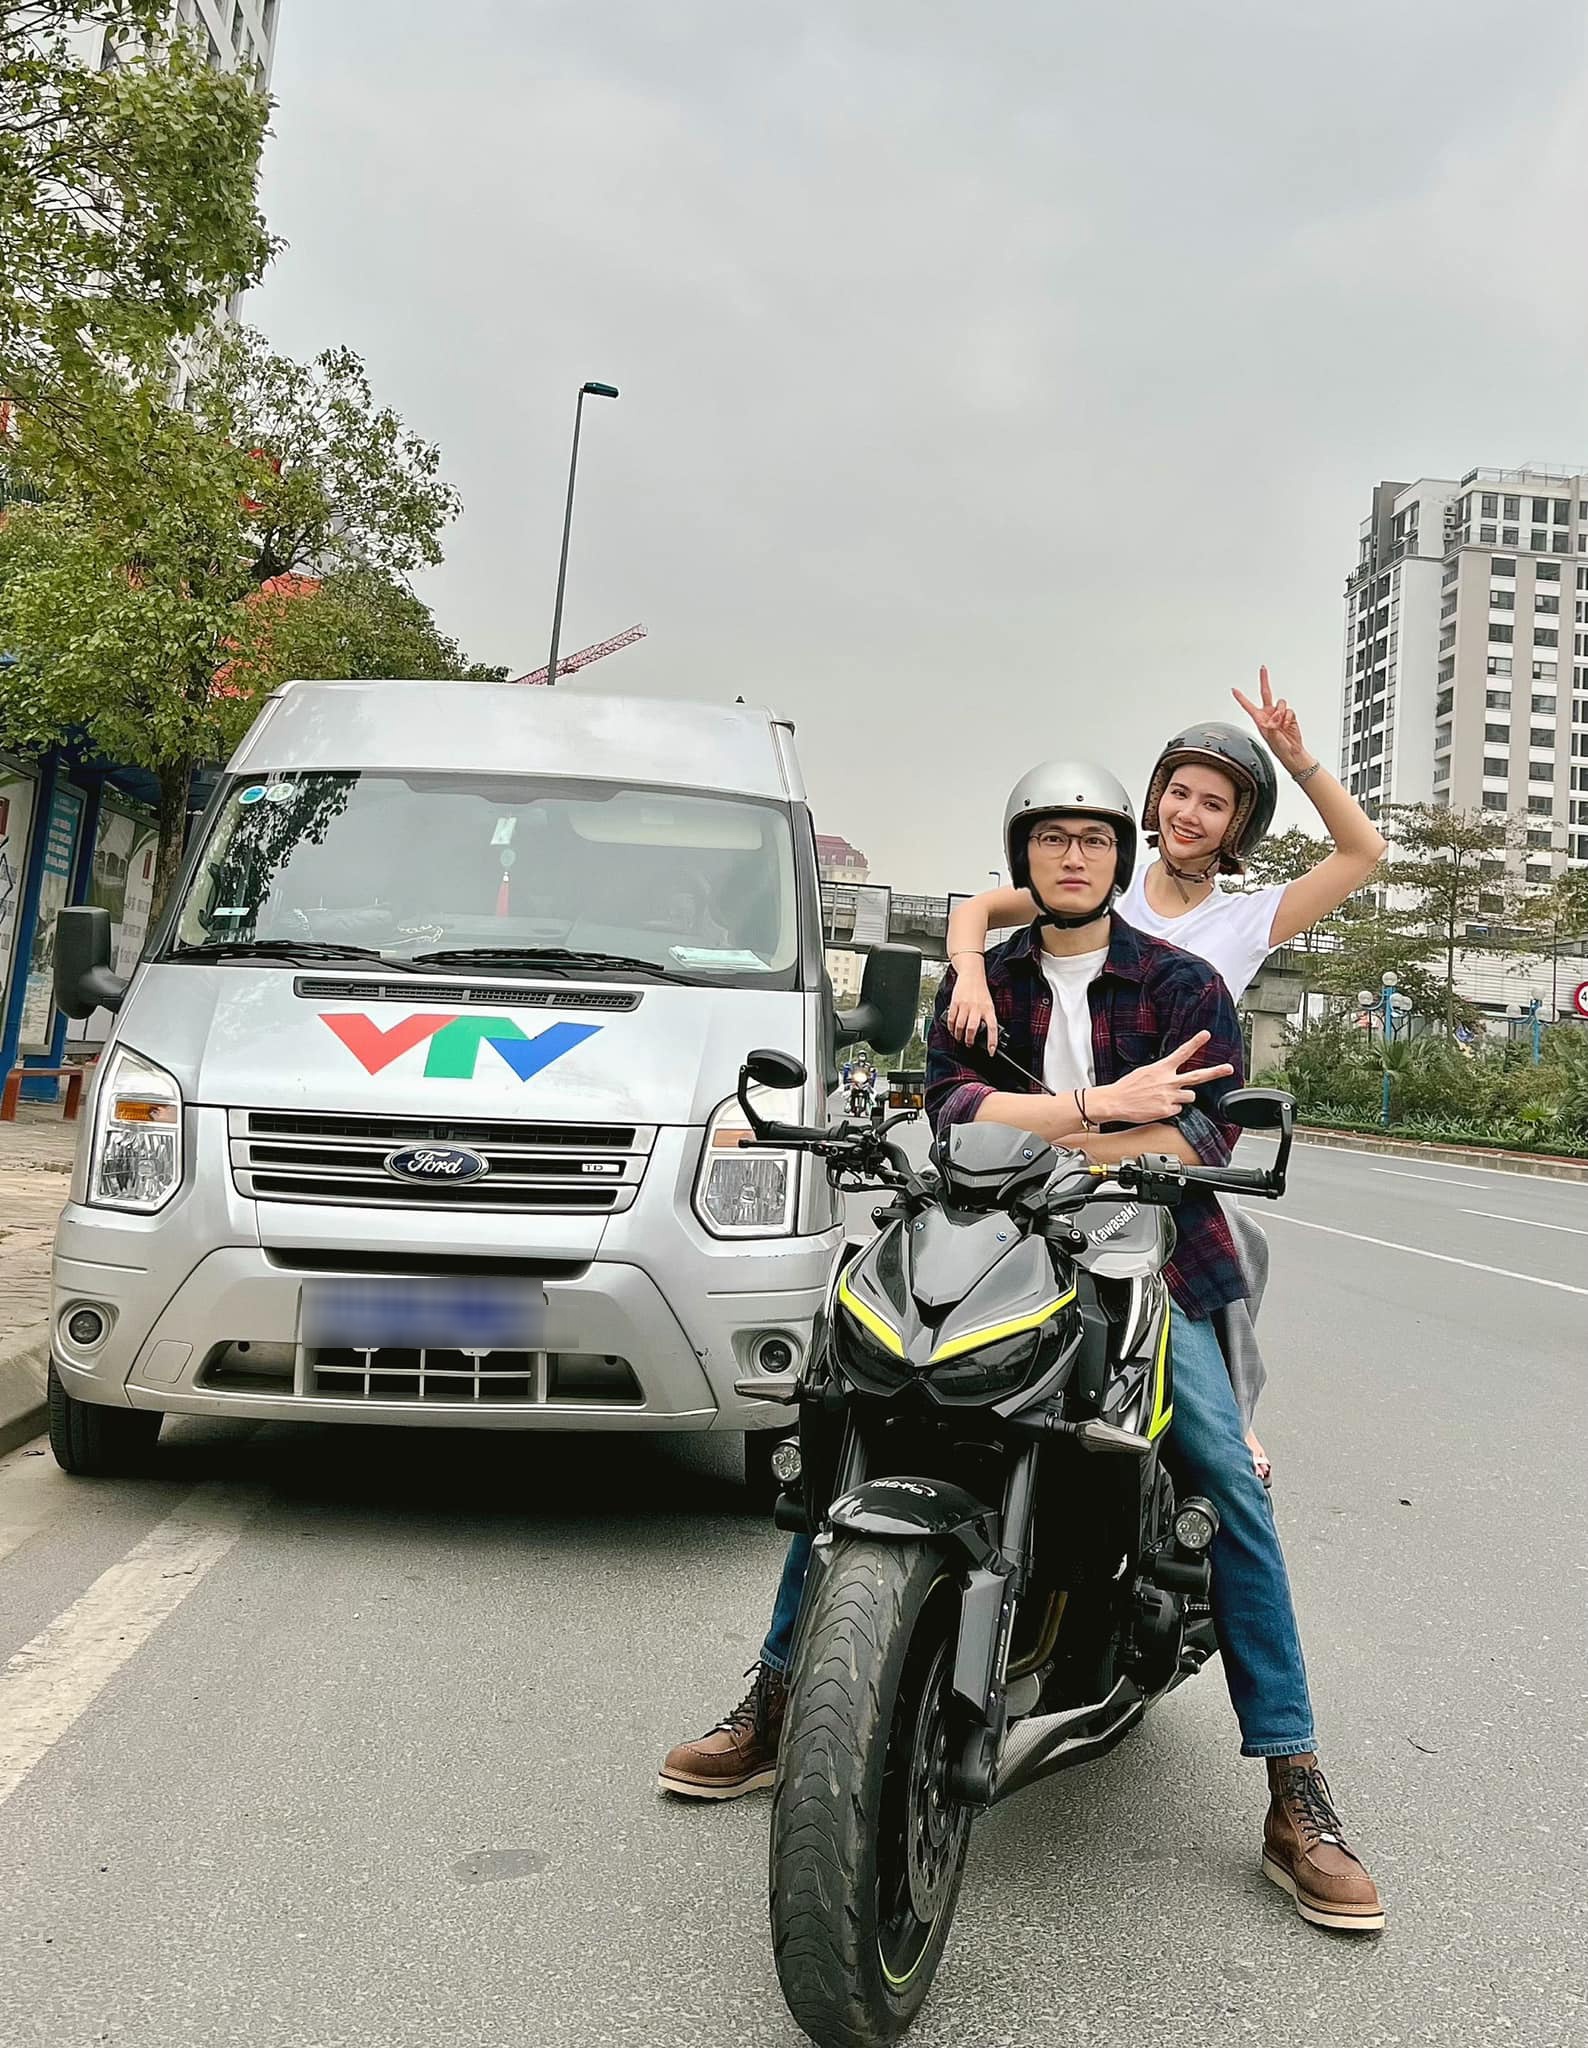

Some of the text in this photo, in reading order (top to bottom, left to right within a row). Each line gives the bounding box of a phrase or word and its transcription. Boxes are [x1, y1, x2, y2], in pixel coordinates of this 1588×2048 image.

[318, 1012, 605, 1082] VTV
[407, 1150, 463, 1174] Ford
[1088, 1201, 1139, 1246] Kawasaki
